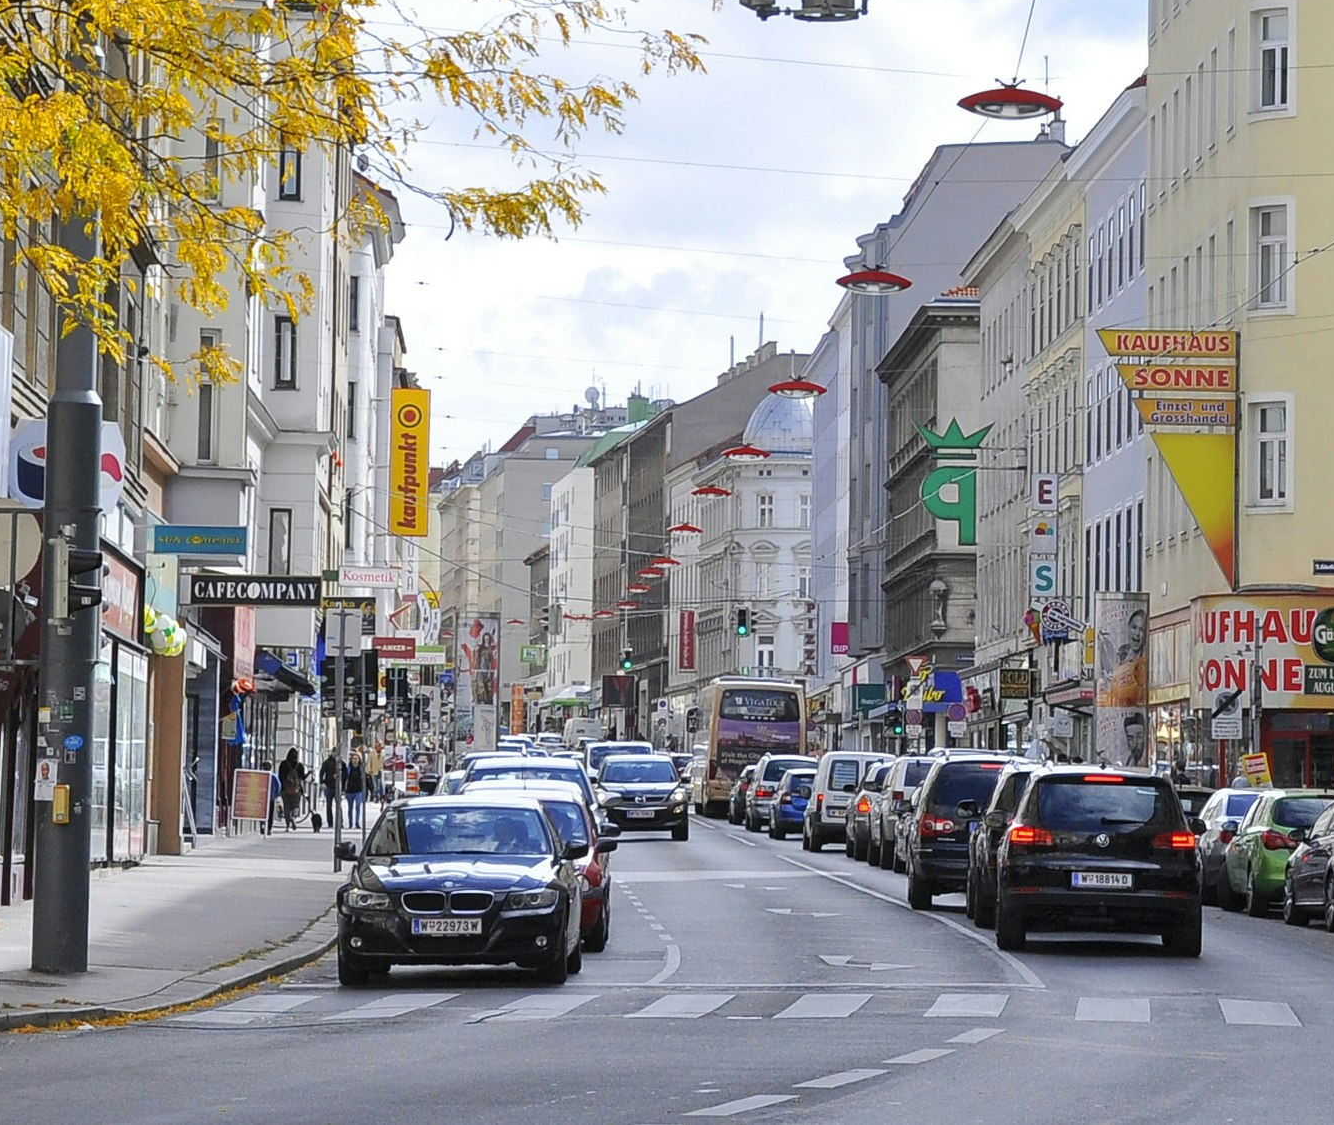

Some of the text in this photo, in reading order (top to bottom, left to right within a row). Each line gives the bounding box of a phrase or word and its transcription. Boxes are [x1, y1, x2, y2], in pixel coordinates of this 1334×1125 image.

[1117, 334, 1230, 352] KAUFHAUS
[1134, 368, 1230, 387] SONNE
[1201, 402, 1225, 412] und
[1150, 412, 1230, 424] Grosshandel
[397, 432, 420, 530] kaufpunkt
[342, 570, 395, 583] Kosmetik
[194, 582, 318, 600] CAFECOMPANY
[804, 603, 816, 676] PIZZA
[382, 644, 407, 652] ANKER
[1308, 667, 1327, 679] ZUM
